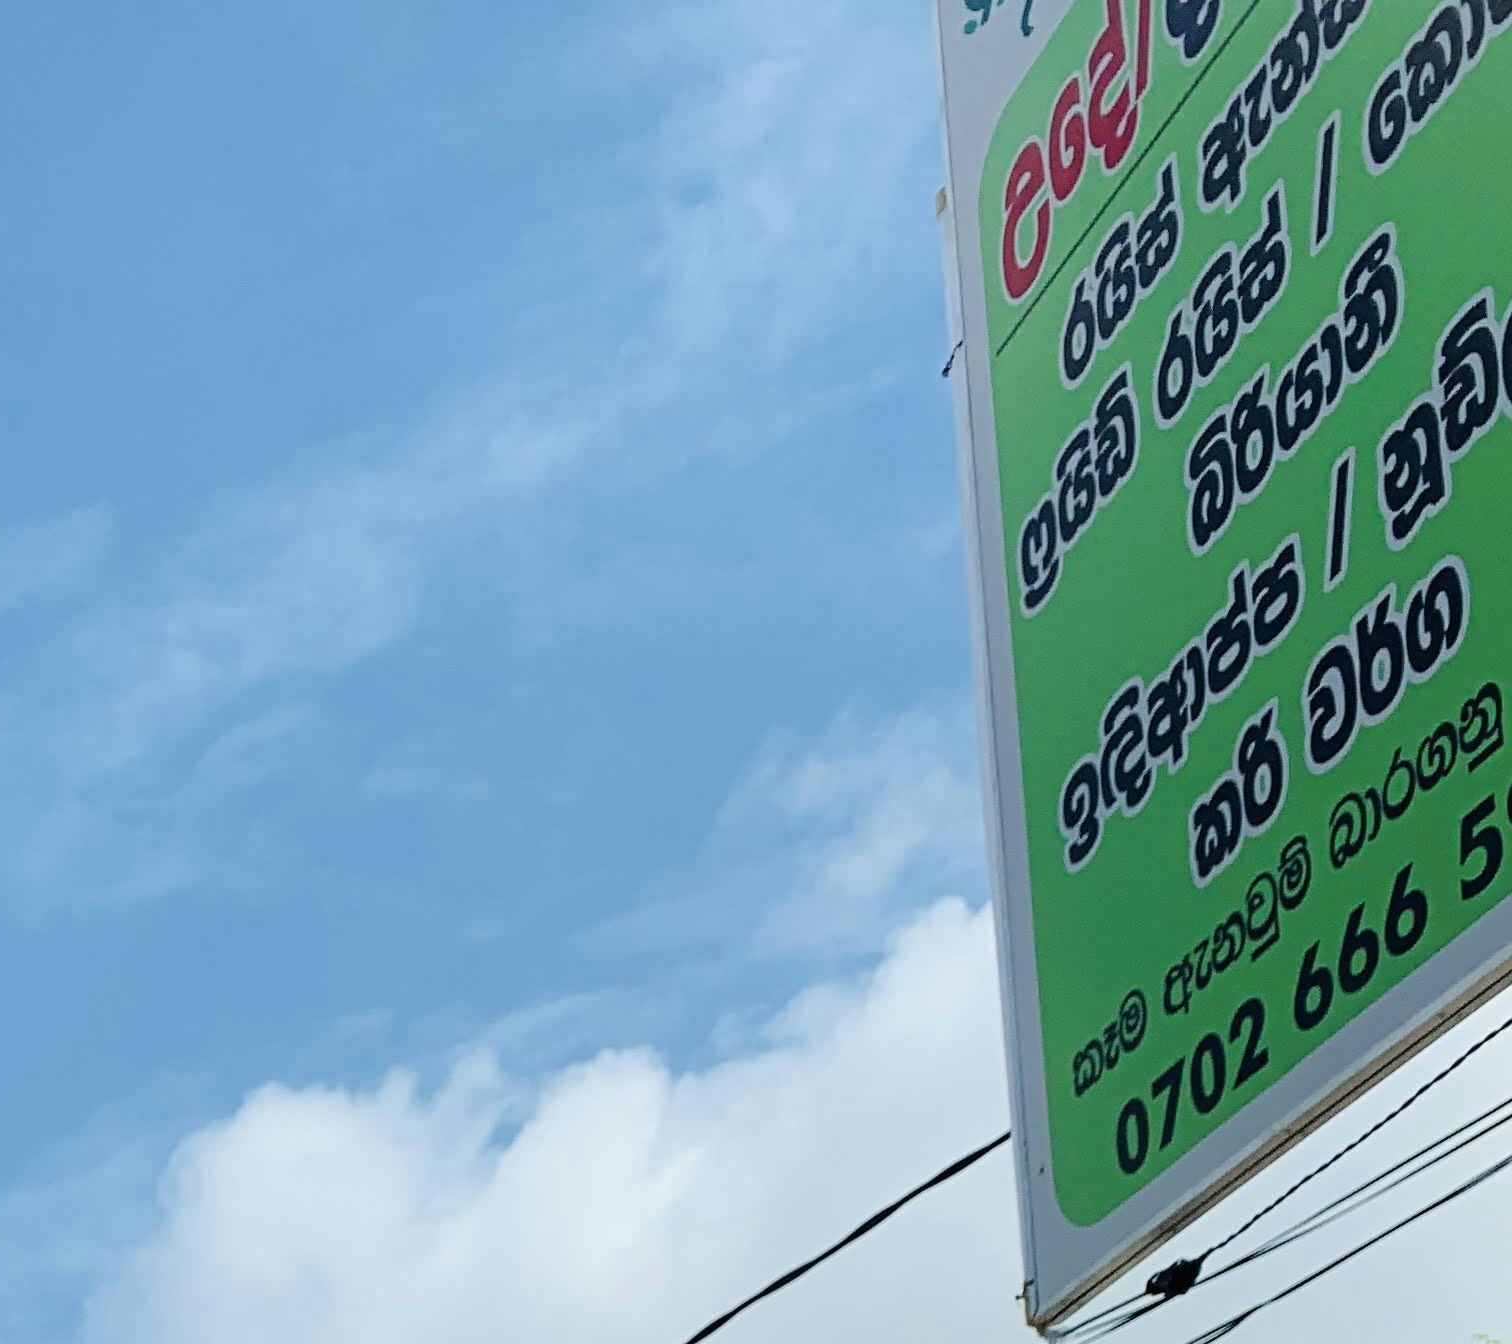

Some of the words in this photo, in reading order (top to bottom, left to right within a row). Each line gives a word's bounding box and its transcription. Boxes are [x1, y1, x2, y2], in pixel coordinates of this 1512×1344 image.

[1063, 162, 1179, 380] රයිස්
[1157, 188, 1286, 420] රයිස්
[1368, 0, 1512, 165] කො
[1383, 298, 1512, 540] නූඩ්
[1193, 707, 1284, 878] කරි
[1308, 565, 1463, 764] වර්ග
[1329, 681, 1505, 869] බාරගනු
[1115, 997, 1270, 1175] 0702
[1293, 861, 1428, 1030] 666
[1459, 793, 1512, 901] 5
